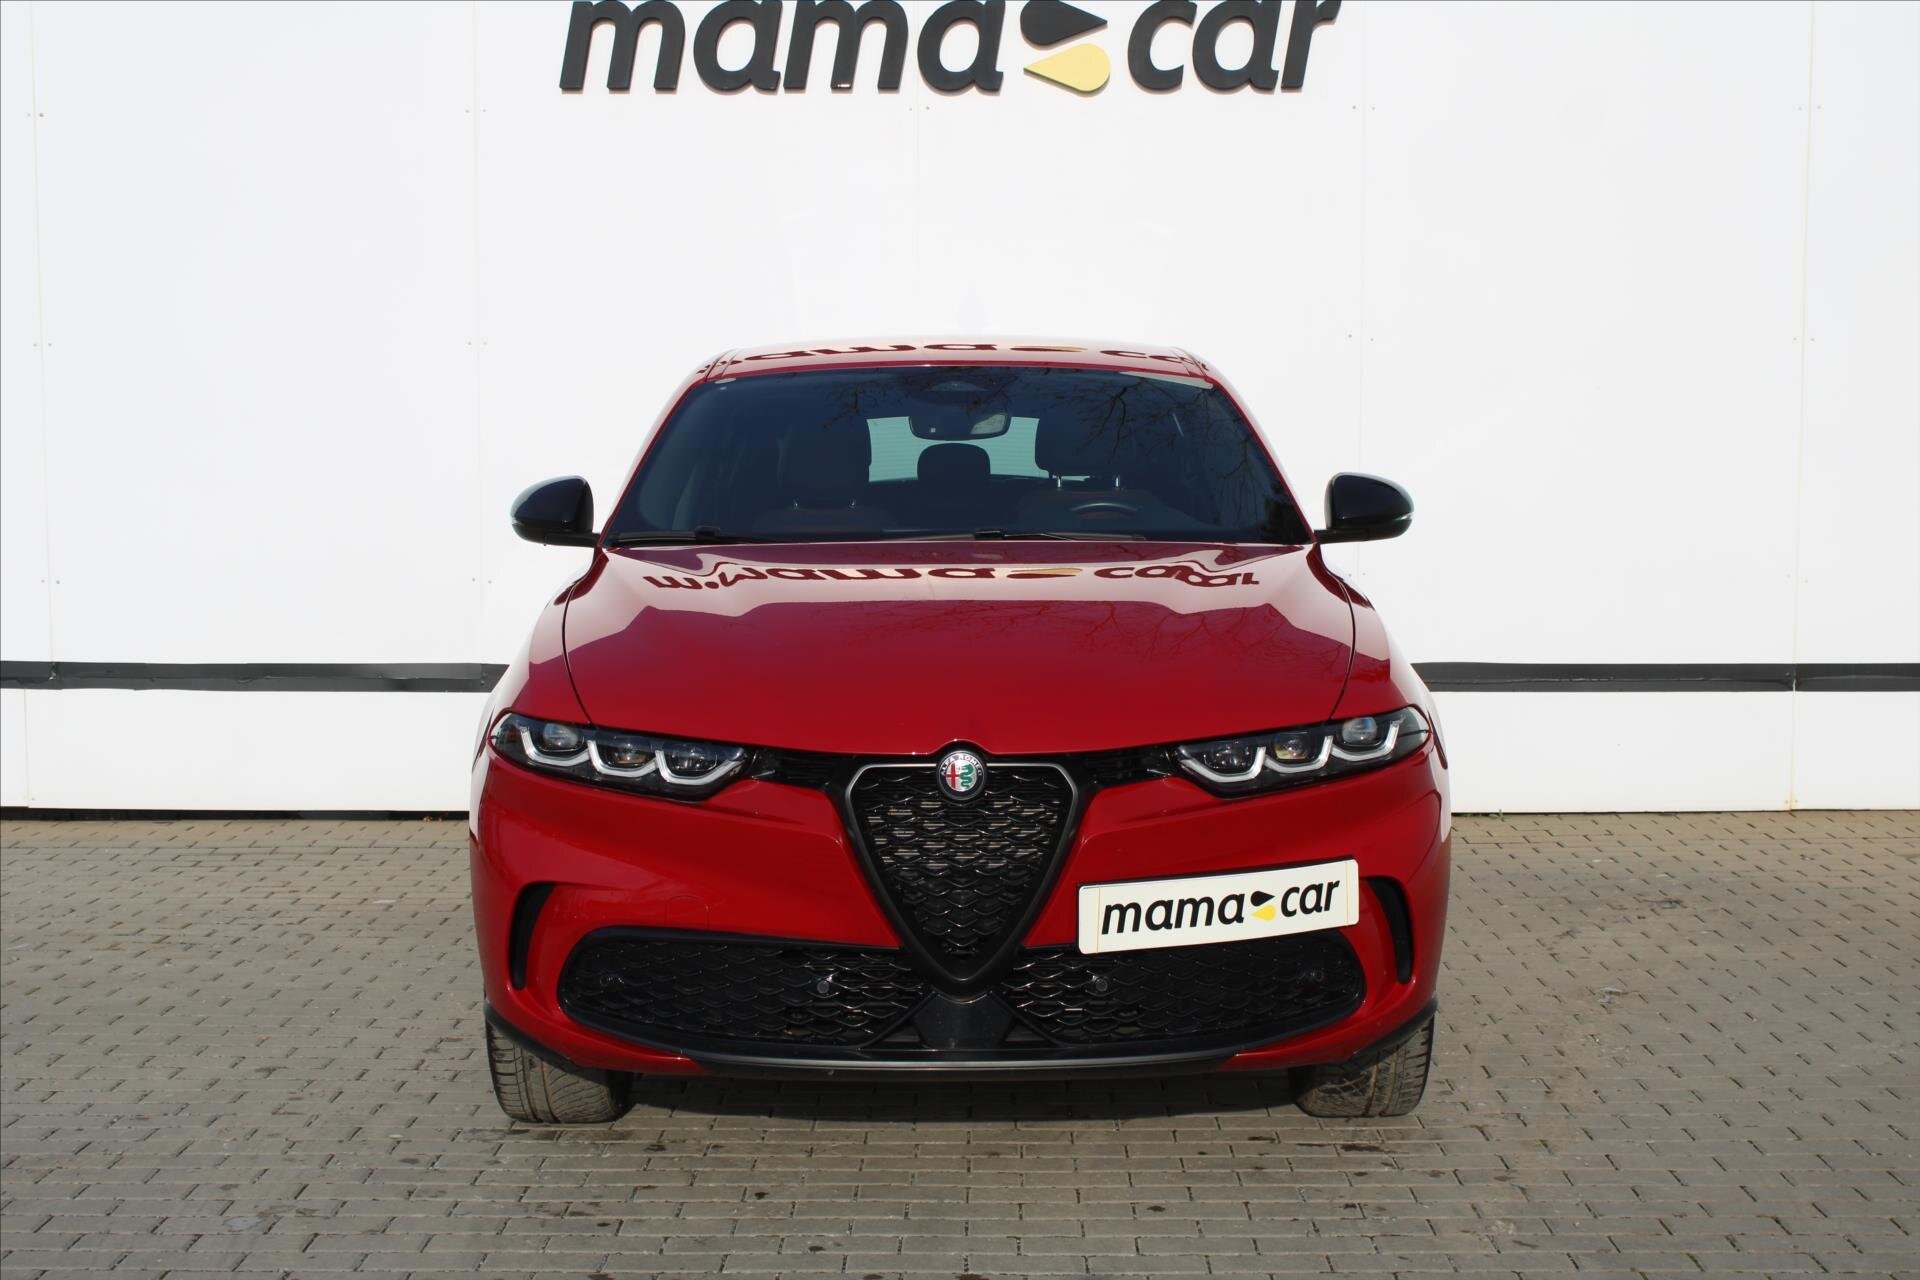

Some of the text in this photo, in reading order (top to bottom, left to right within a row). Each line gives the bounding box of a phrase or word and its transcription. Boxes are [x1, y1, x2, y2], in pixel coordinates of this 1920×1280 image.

[559, 0, 1342, 93] mama car
[1101, 880, 1341, 935] mama car
